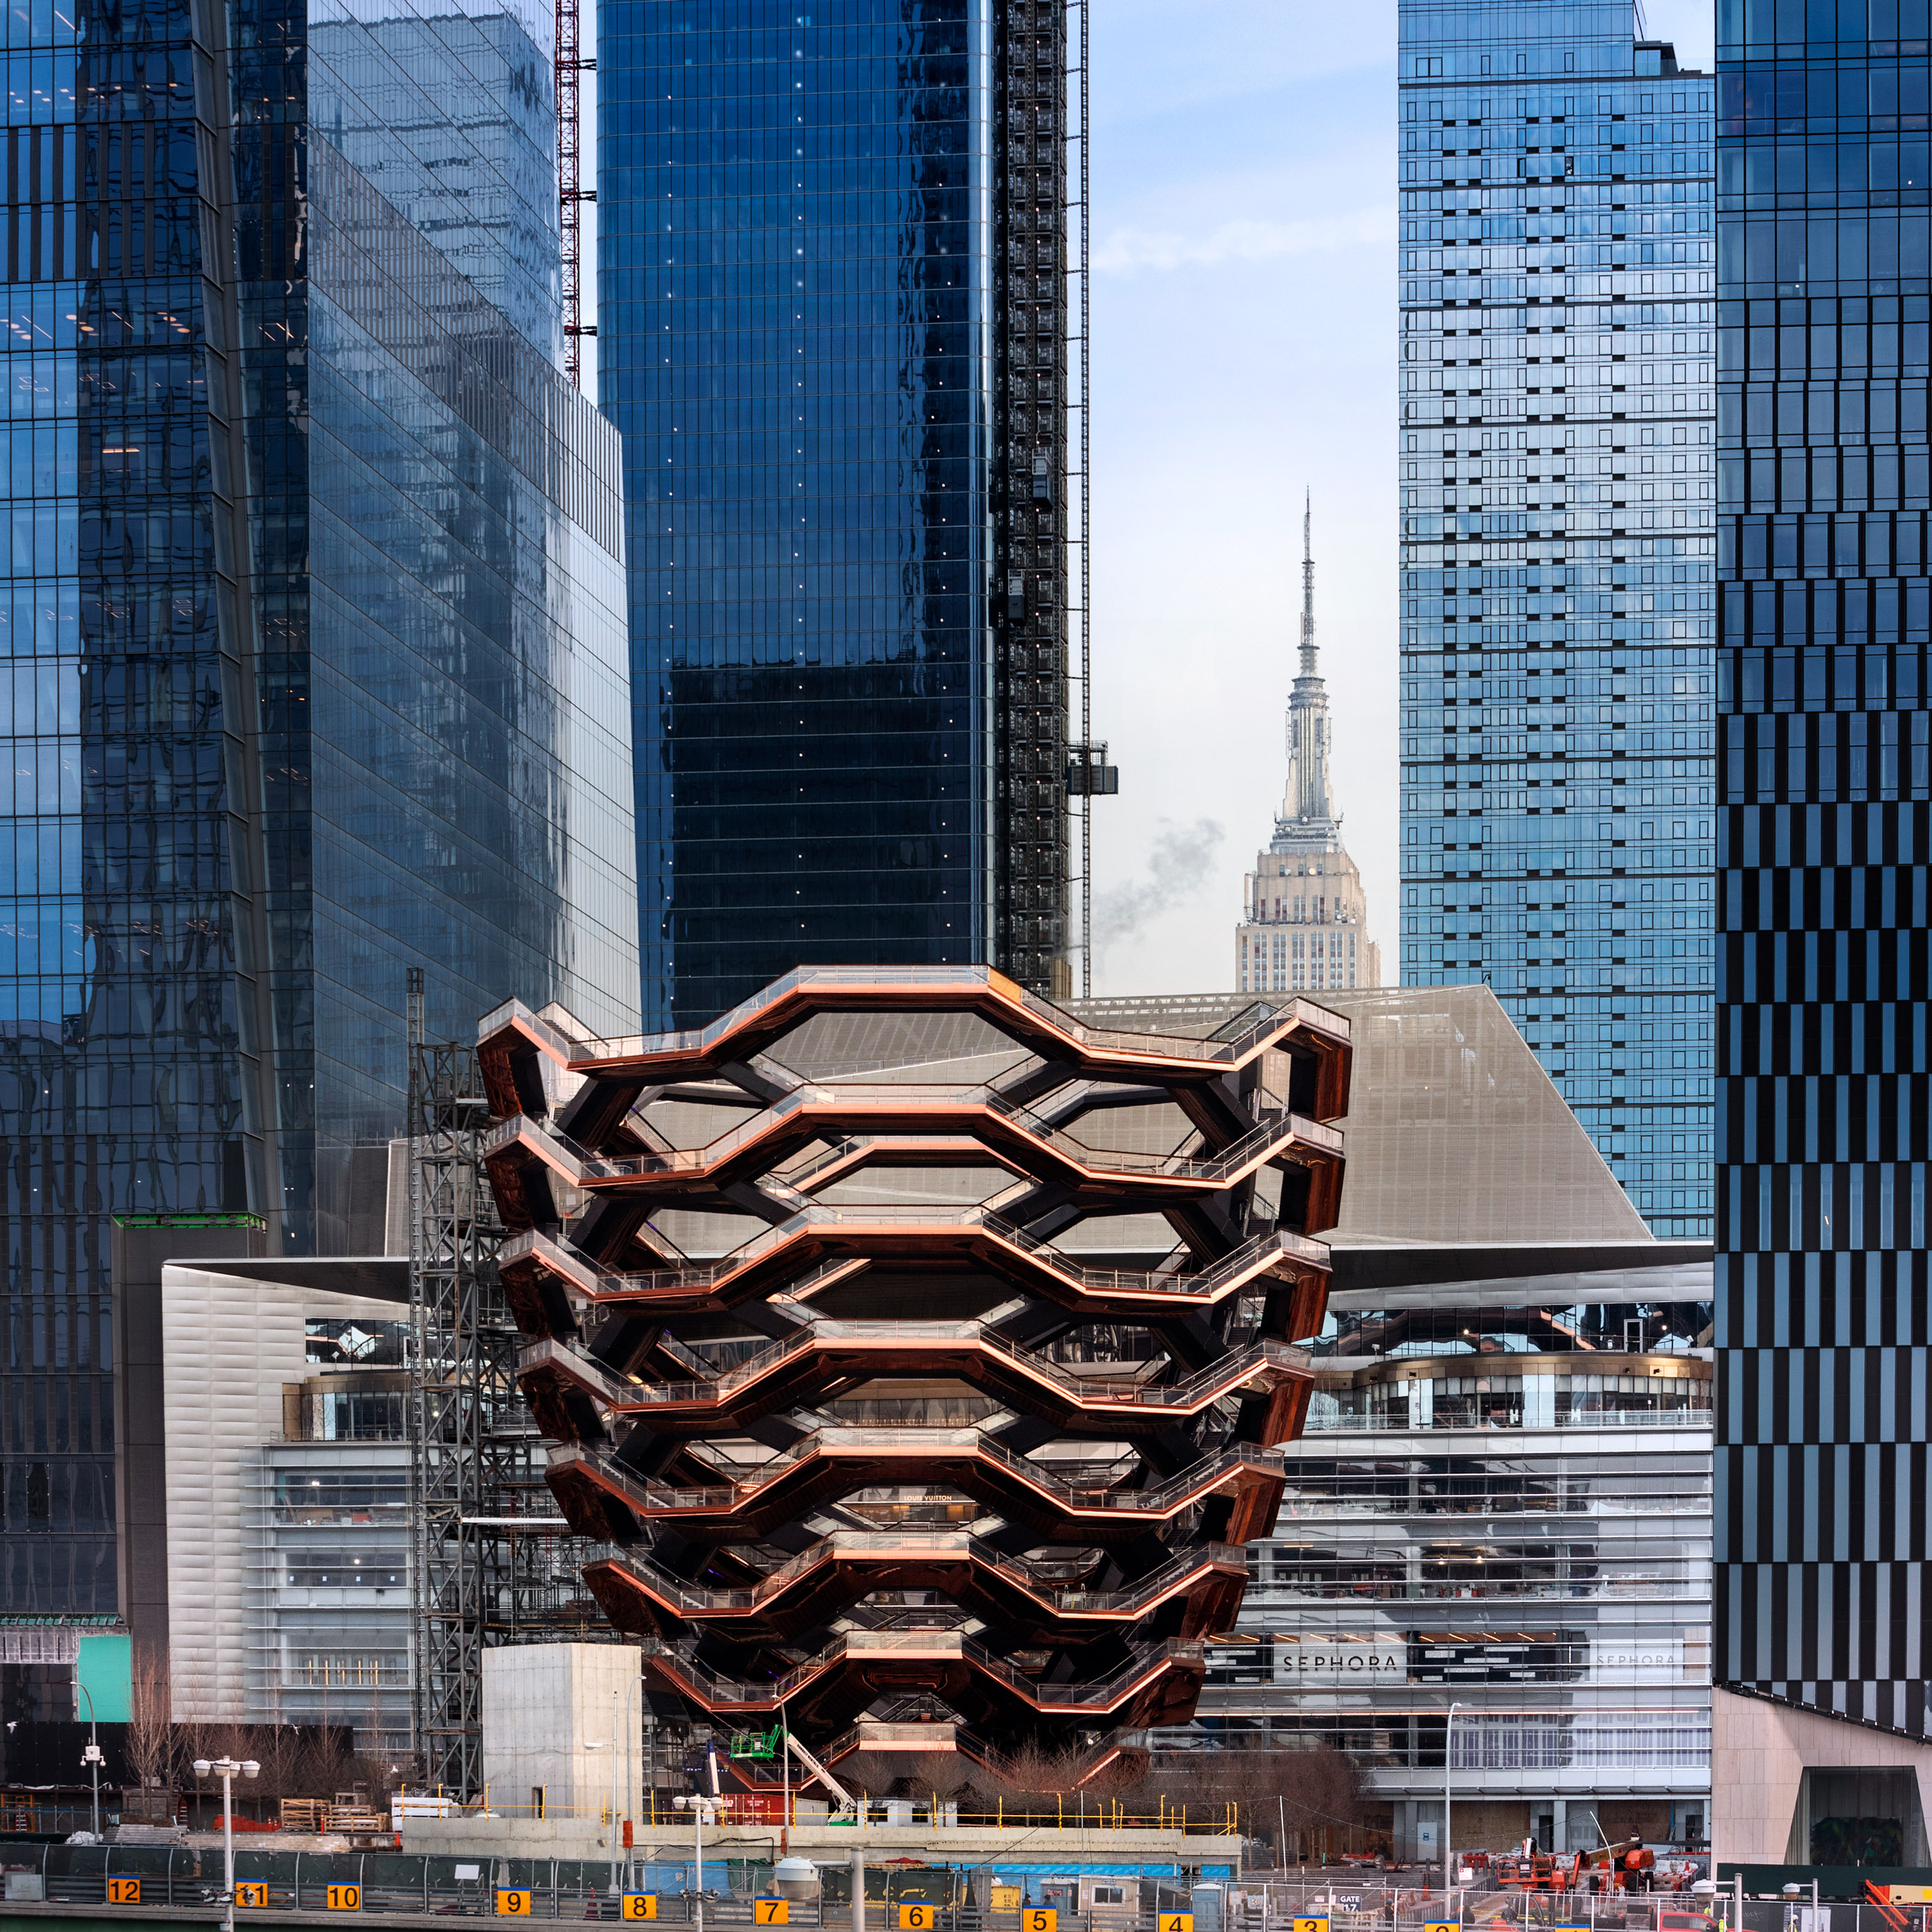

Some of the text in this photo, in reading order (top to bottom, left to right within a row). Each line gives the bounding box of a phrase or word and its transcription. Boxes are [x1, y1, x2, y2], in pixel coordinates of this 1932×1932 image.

[1283, 1655, 1398, 1672] SEPHORA
[1597, 1655, 1675, 1666] SEPHORA
[110, 1881, 138, 1901] 12
[329, 1887, 358, 1907] 10
[507, 1892, 521, 1912] 9
[633, 1896, 647, 1916] 8
[764, 1902, 779, 1922] 7
[1344, 1903, 1357, 1912] 17
[909, 1906, 924, 1927] 6
[1032, 1911, 1047, 1931] 5
[1169, 1916, 1183, 1932] 4
